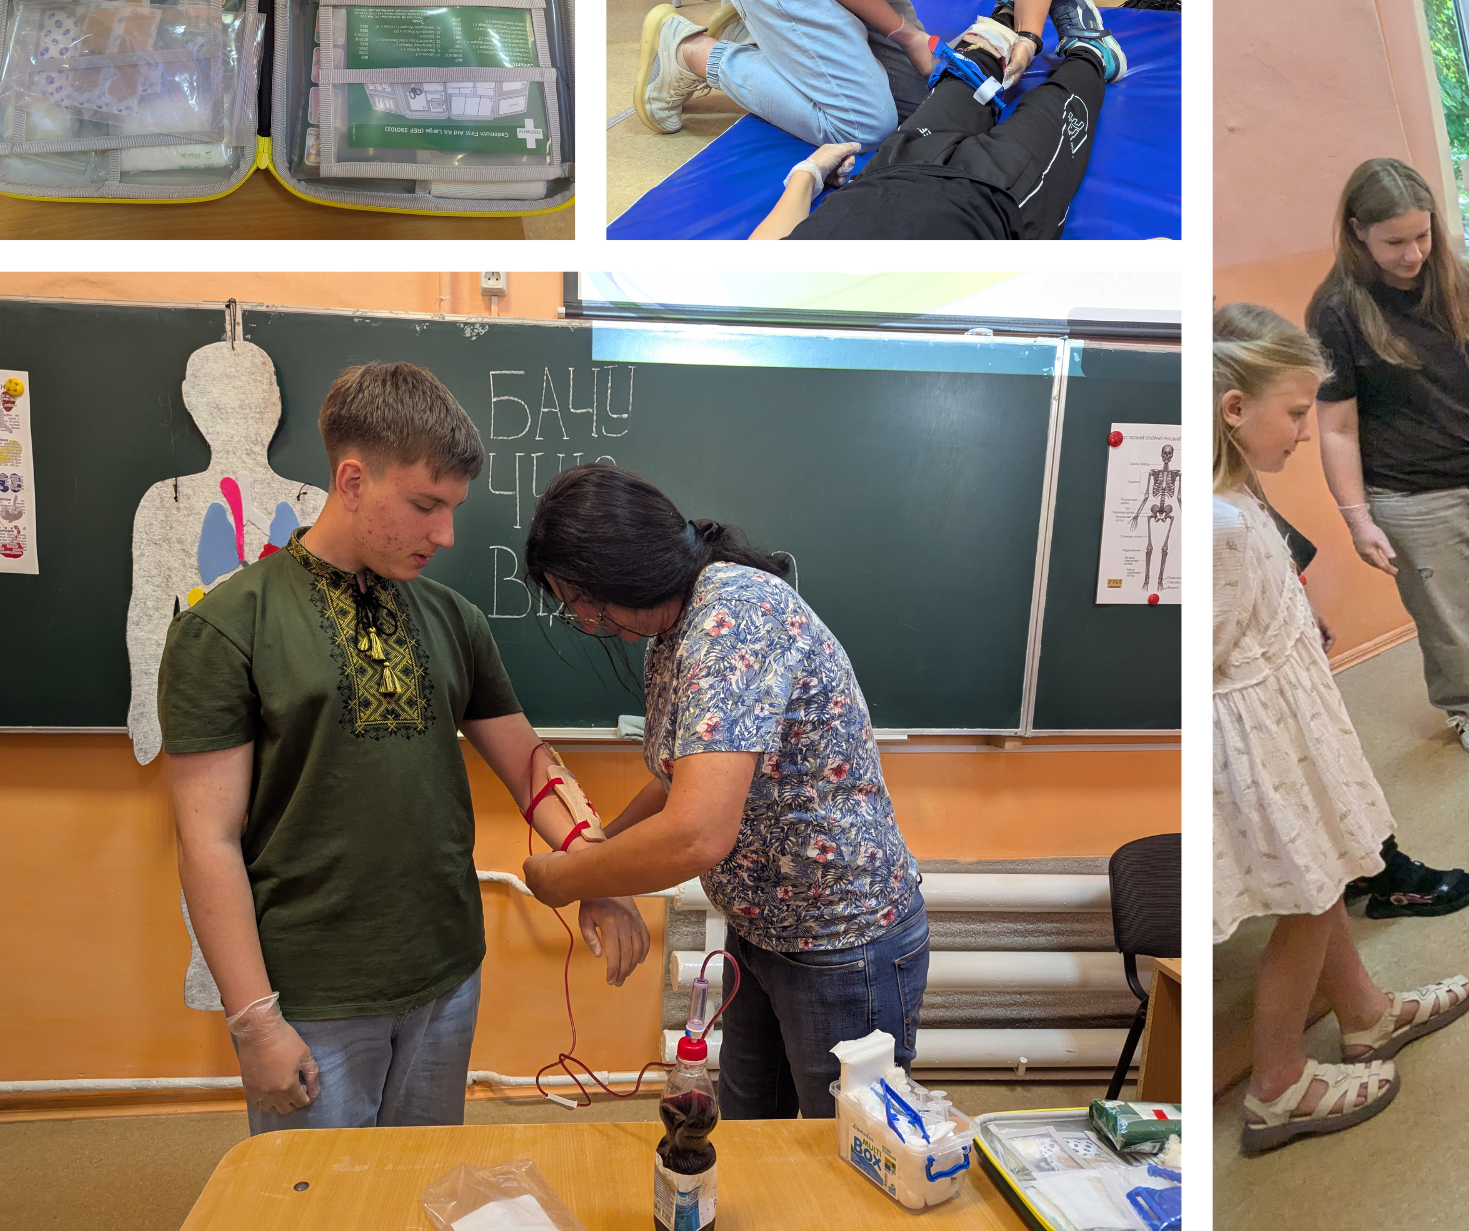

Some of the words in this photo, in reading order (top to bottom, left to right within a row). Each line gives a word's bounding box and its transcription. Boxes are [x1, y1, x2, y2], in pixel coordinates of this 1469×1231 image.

[489, 364, 637, 441] БАЧУ
[853, 1135, 882, 1172] BOX
[862, 1138, 882, 1158] MULTI
